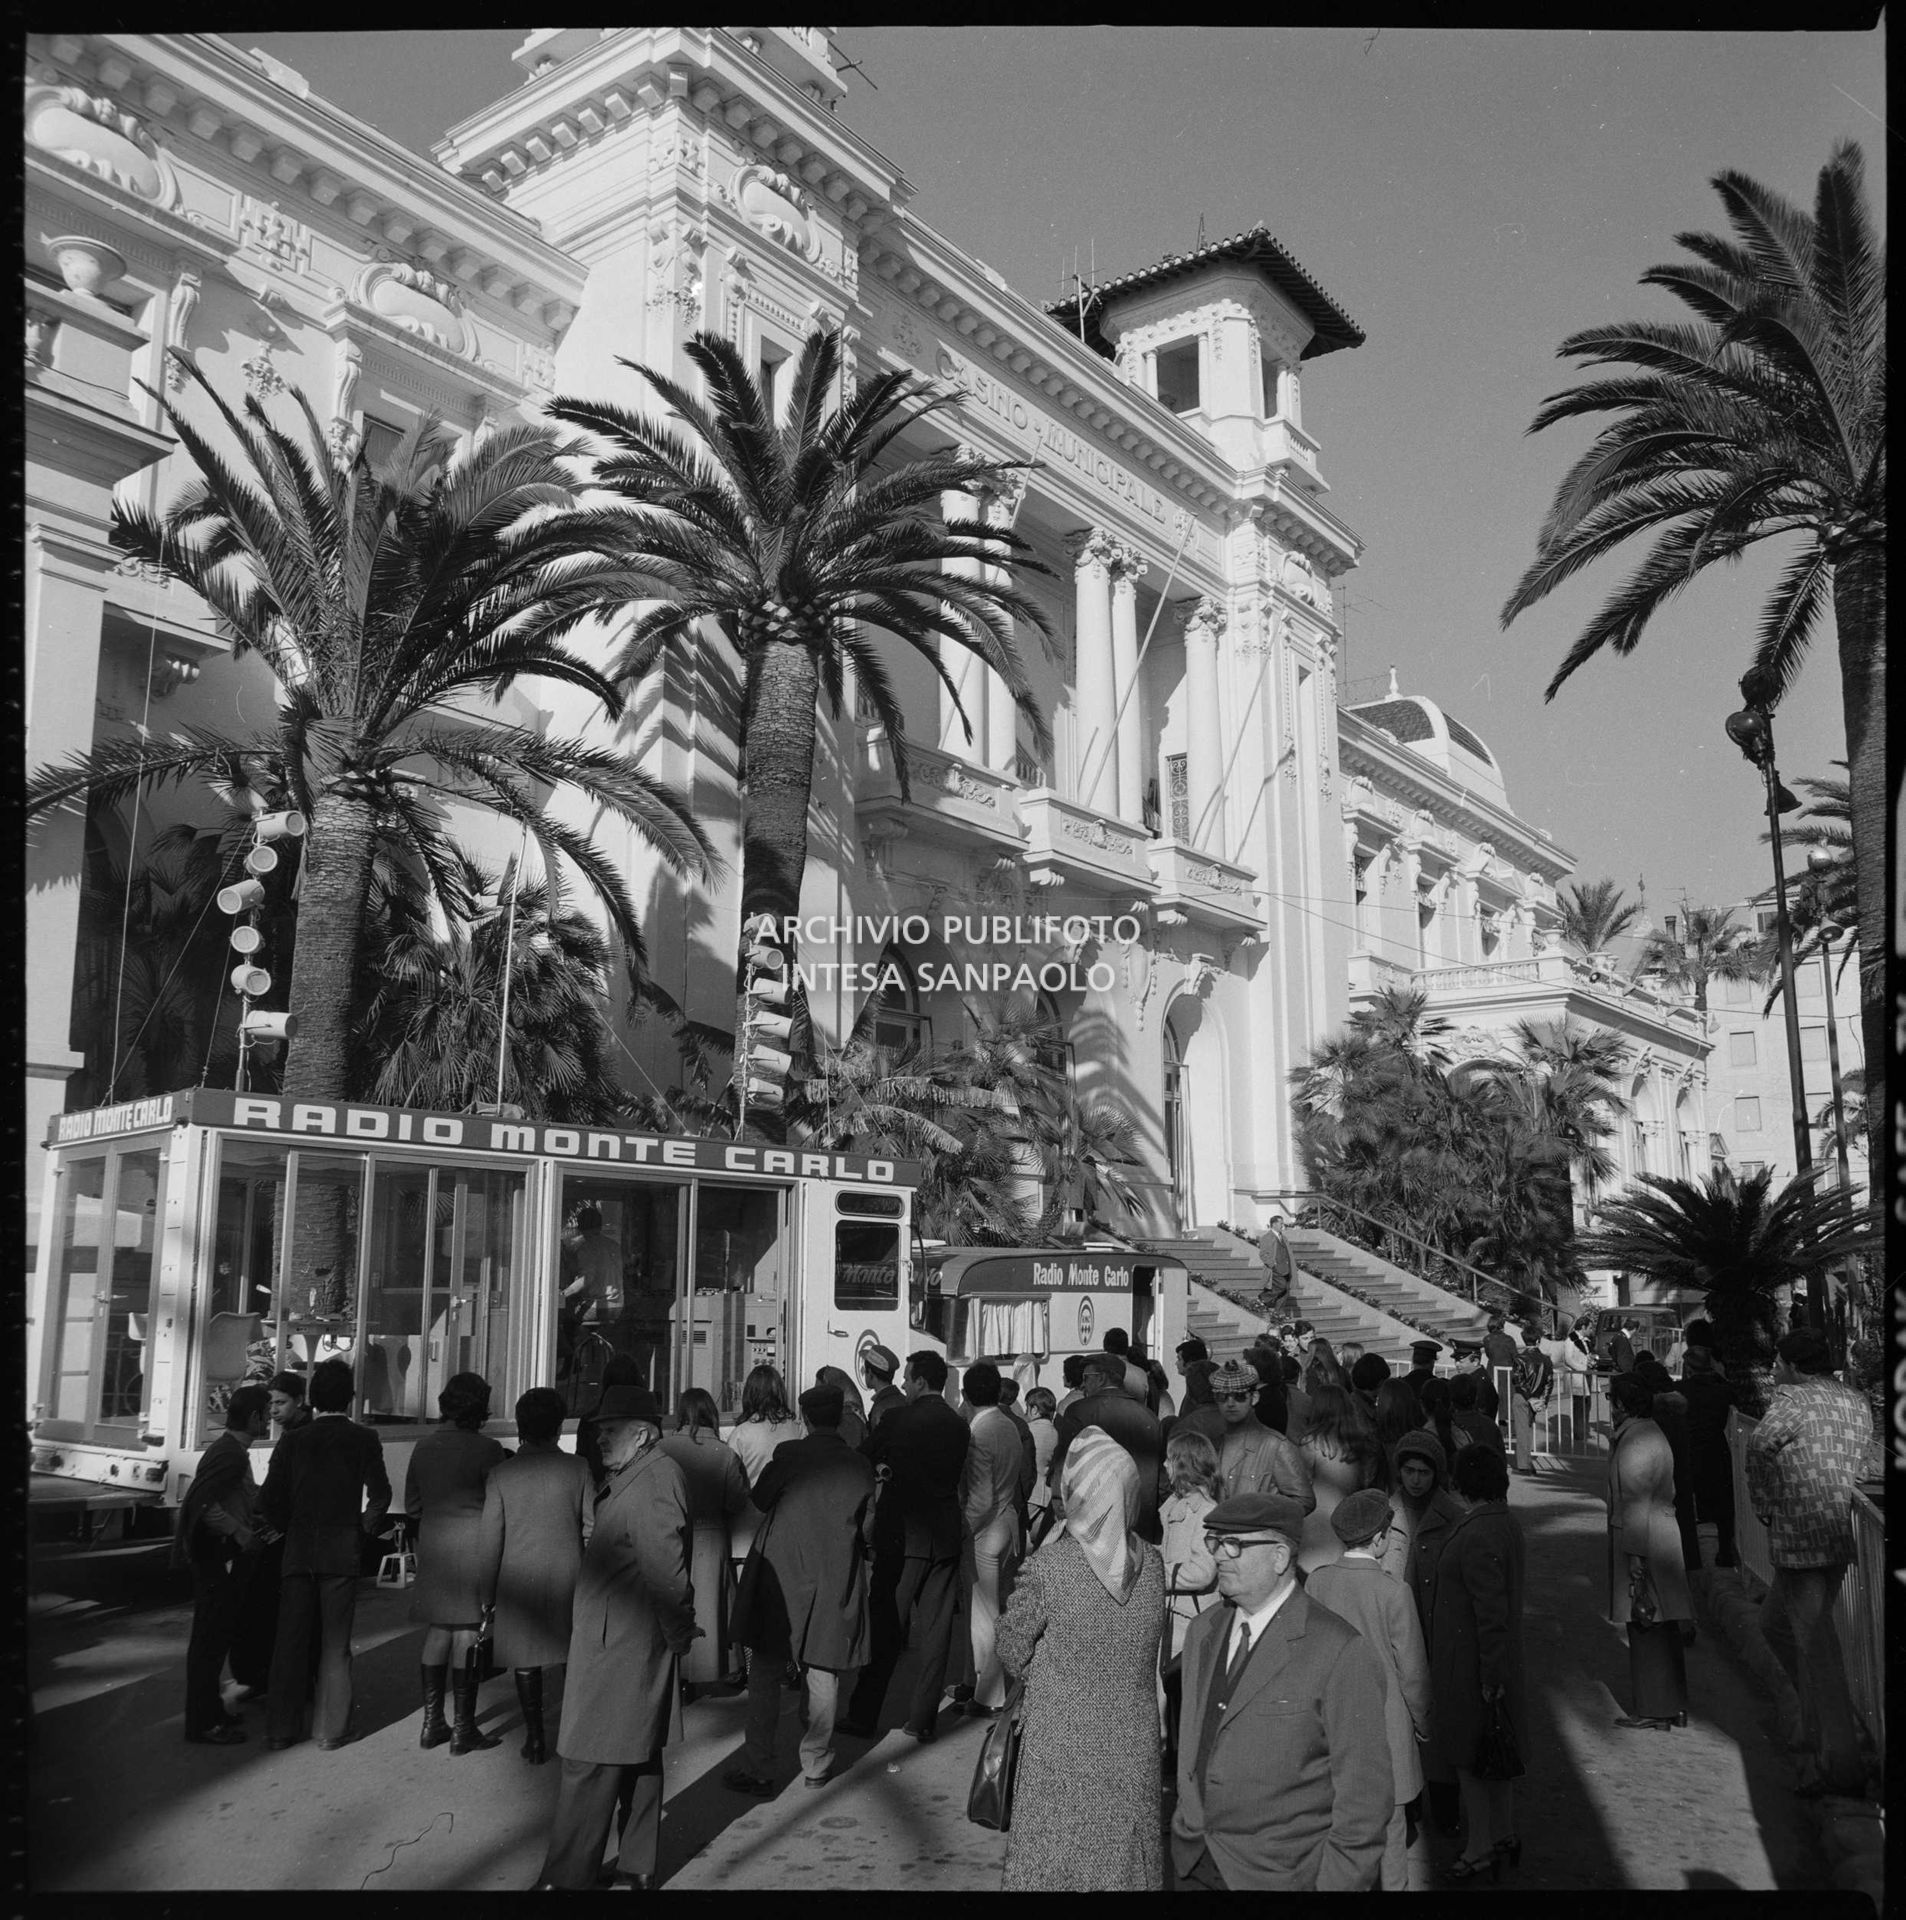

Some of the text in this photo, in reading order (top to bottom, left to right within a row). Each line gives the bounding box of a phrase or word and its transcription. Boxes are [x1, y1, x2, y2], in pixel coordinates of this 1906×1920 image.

[935, 348, 1166, 524] CASINO MUNICIPALE
[58, 1096, 174, 1142] RADIO MONTE CARLO
[233, 1097, 894, 1182] RADIO MONTE CARLO
[1033, 1262, 1129, 1287] Radio Monte Carlo
